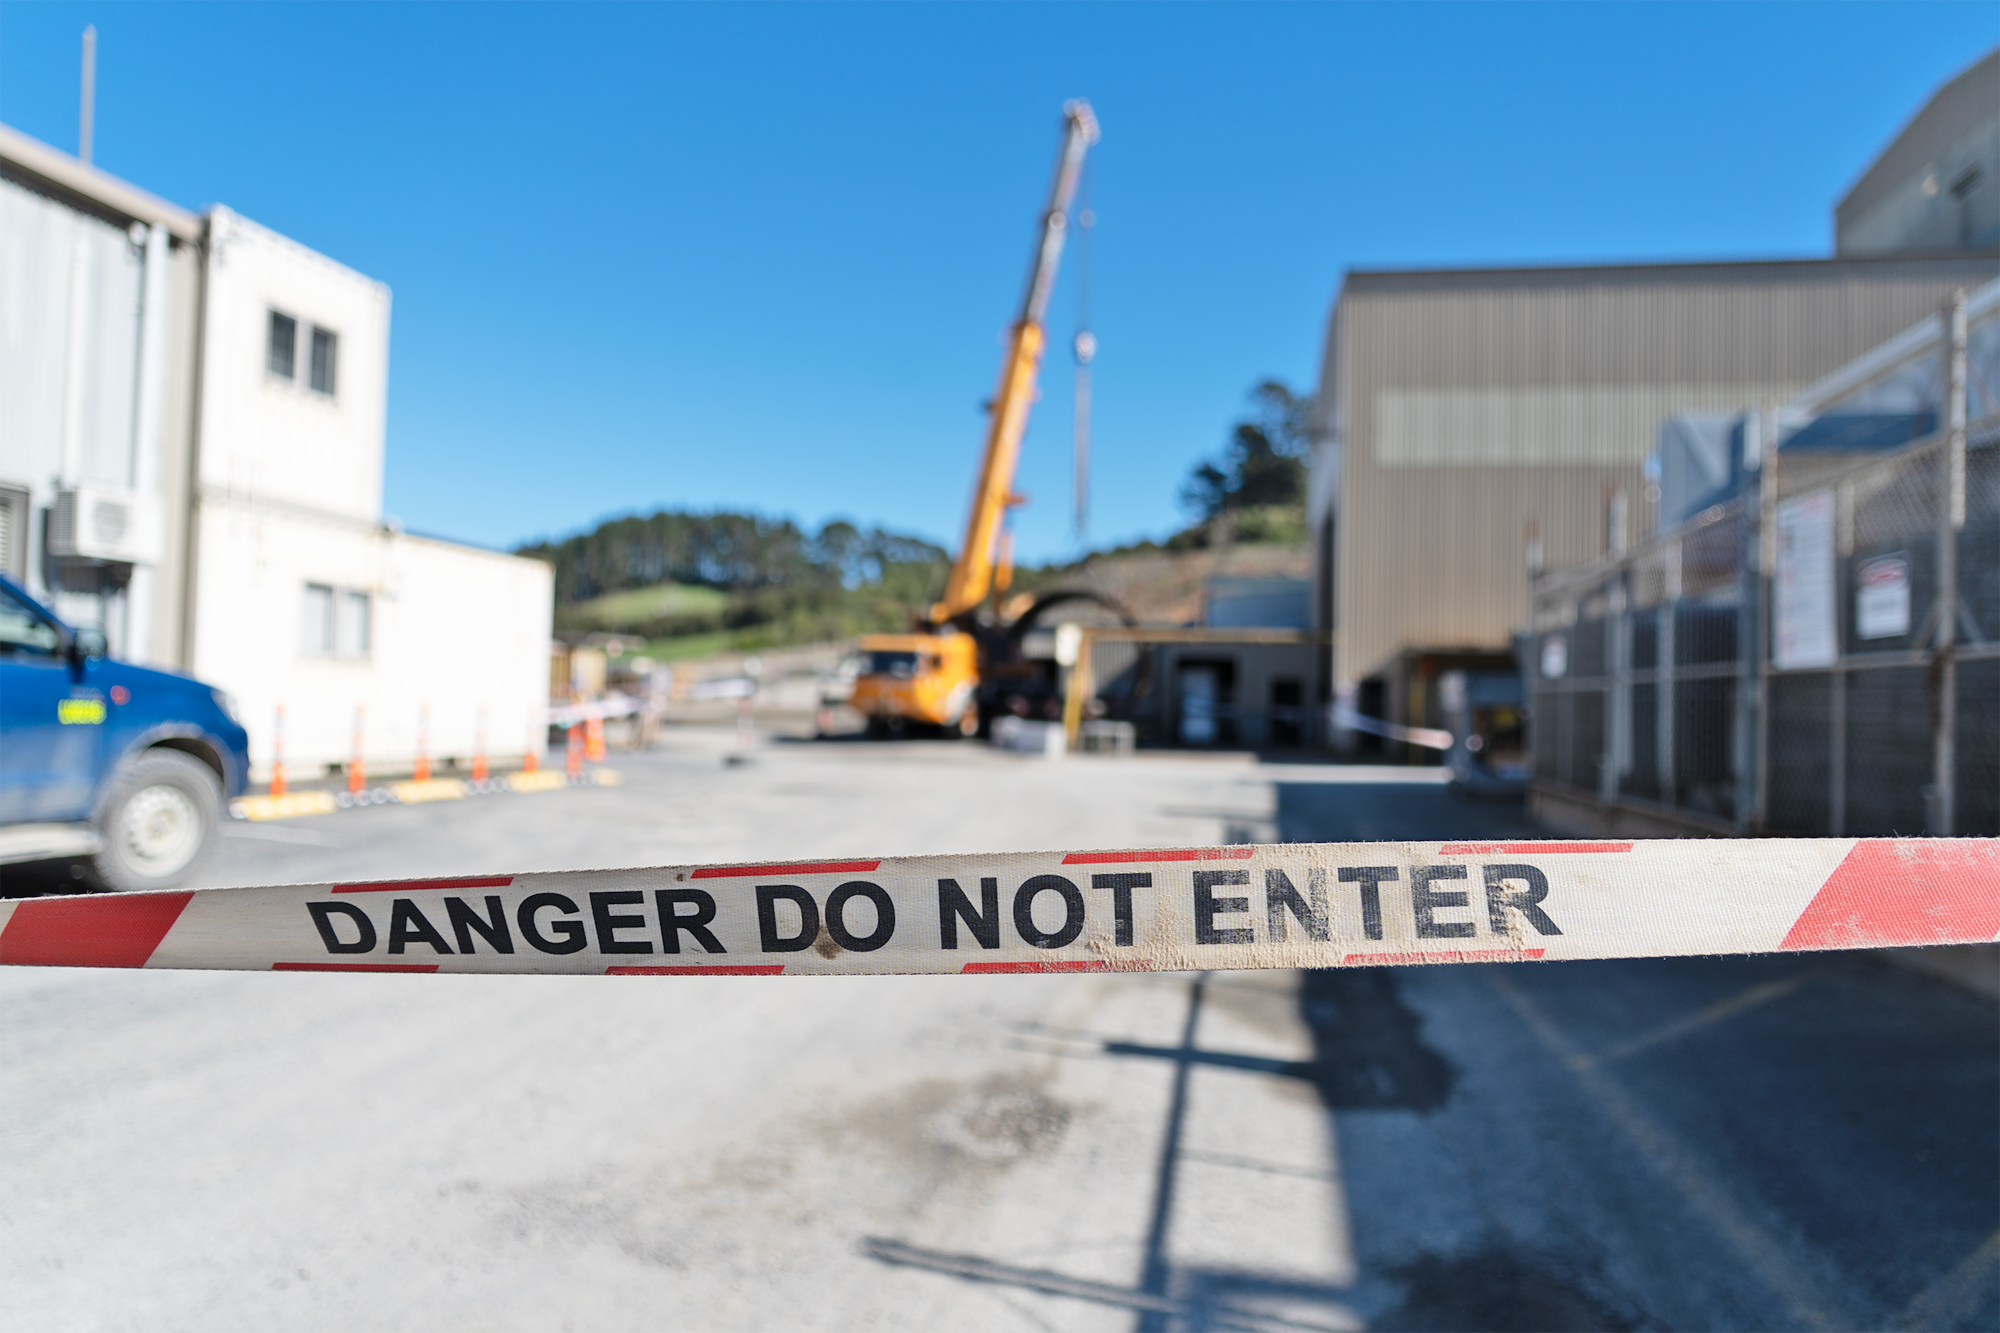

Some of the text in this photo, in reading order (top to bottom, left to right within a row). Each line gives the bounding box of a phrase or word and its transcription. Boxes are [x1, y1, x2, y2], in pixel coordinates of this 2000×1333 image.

[306, 864, 1563, 955] DANGER DO NOT ENTER
